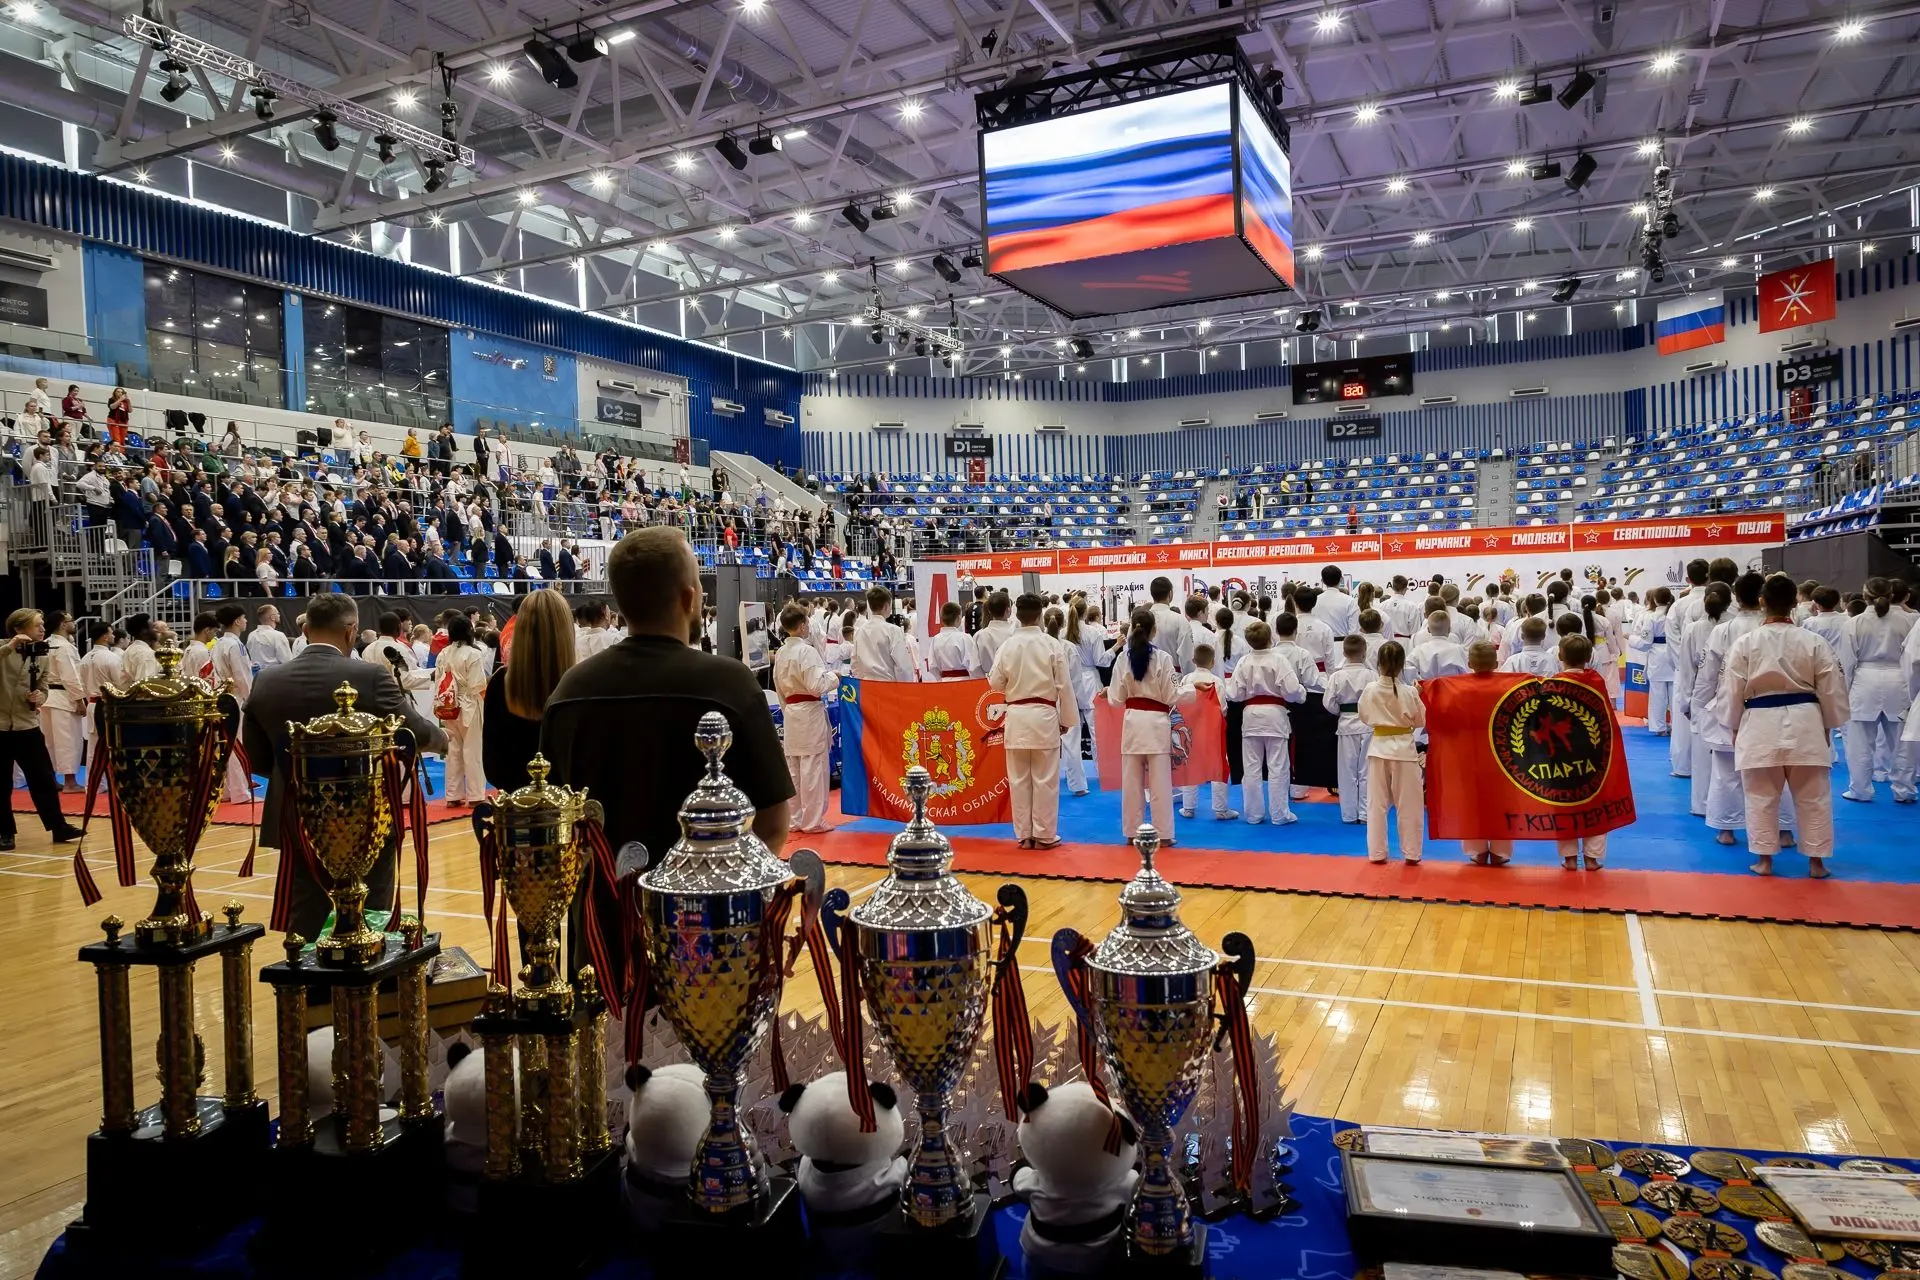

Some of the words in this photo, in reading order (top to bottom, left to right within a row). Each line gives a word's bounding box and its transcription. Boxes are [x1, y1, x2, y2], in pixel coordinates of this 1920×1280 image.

[0, 297, 29, 307] ЕКТОР
[0, 306, 29, 316] ECTOR
[1783, 364, 1811, 384] D3
[1332, 423, 1357, 437] D2
[954, 441, 970, 453] D1
[1613, 525, 1691, 541] СЕВАСТОПОЛЬ
[1737, 520, 1772, 535] ТУЛА
[1217, 546, 1266, 559] БРЕСТСКАЯ
[1269, 544, 1315, 556] КРЕПОСТЬ
[1351, 540, 1380, 553] КЕРЧЬ
[1415, 536, 1471, 550] МУРМАНСК
[1511, 532, 1566, 546] СМОЛЕНСК
[956, 559, 992, 570] ЕНИНГРАД
[1021, 556, 1052, 568] МОСКВА
[1088, 552, 1147, 566] НОВОРОССИЙСК
[1180, 549, 1209, 560] МИНСК
[1528, 758, 1596, 780] СПАРТА
[872, 776, 957, 818] ВЛАДИМСКАЯ
